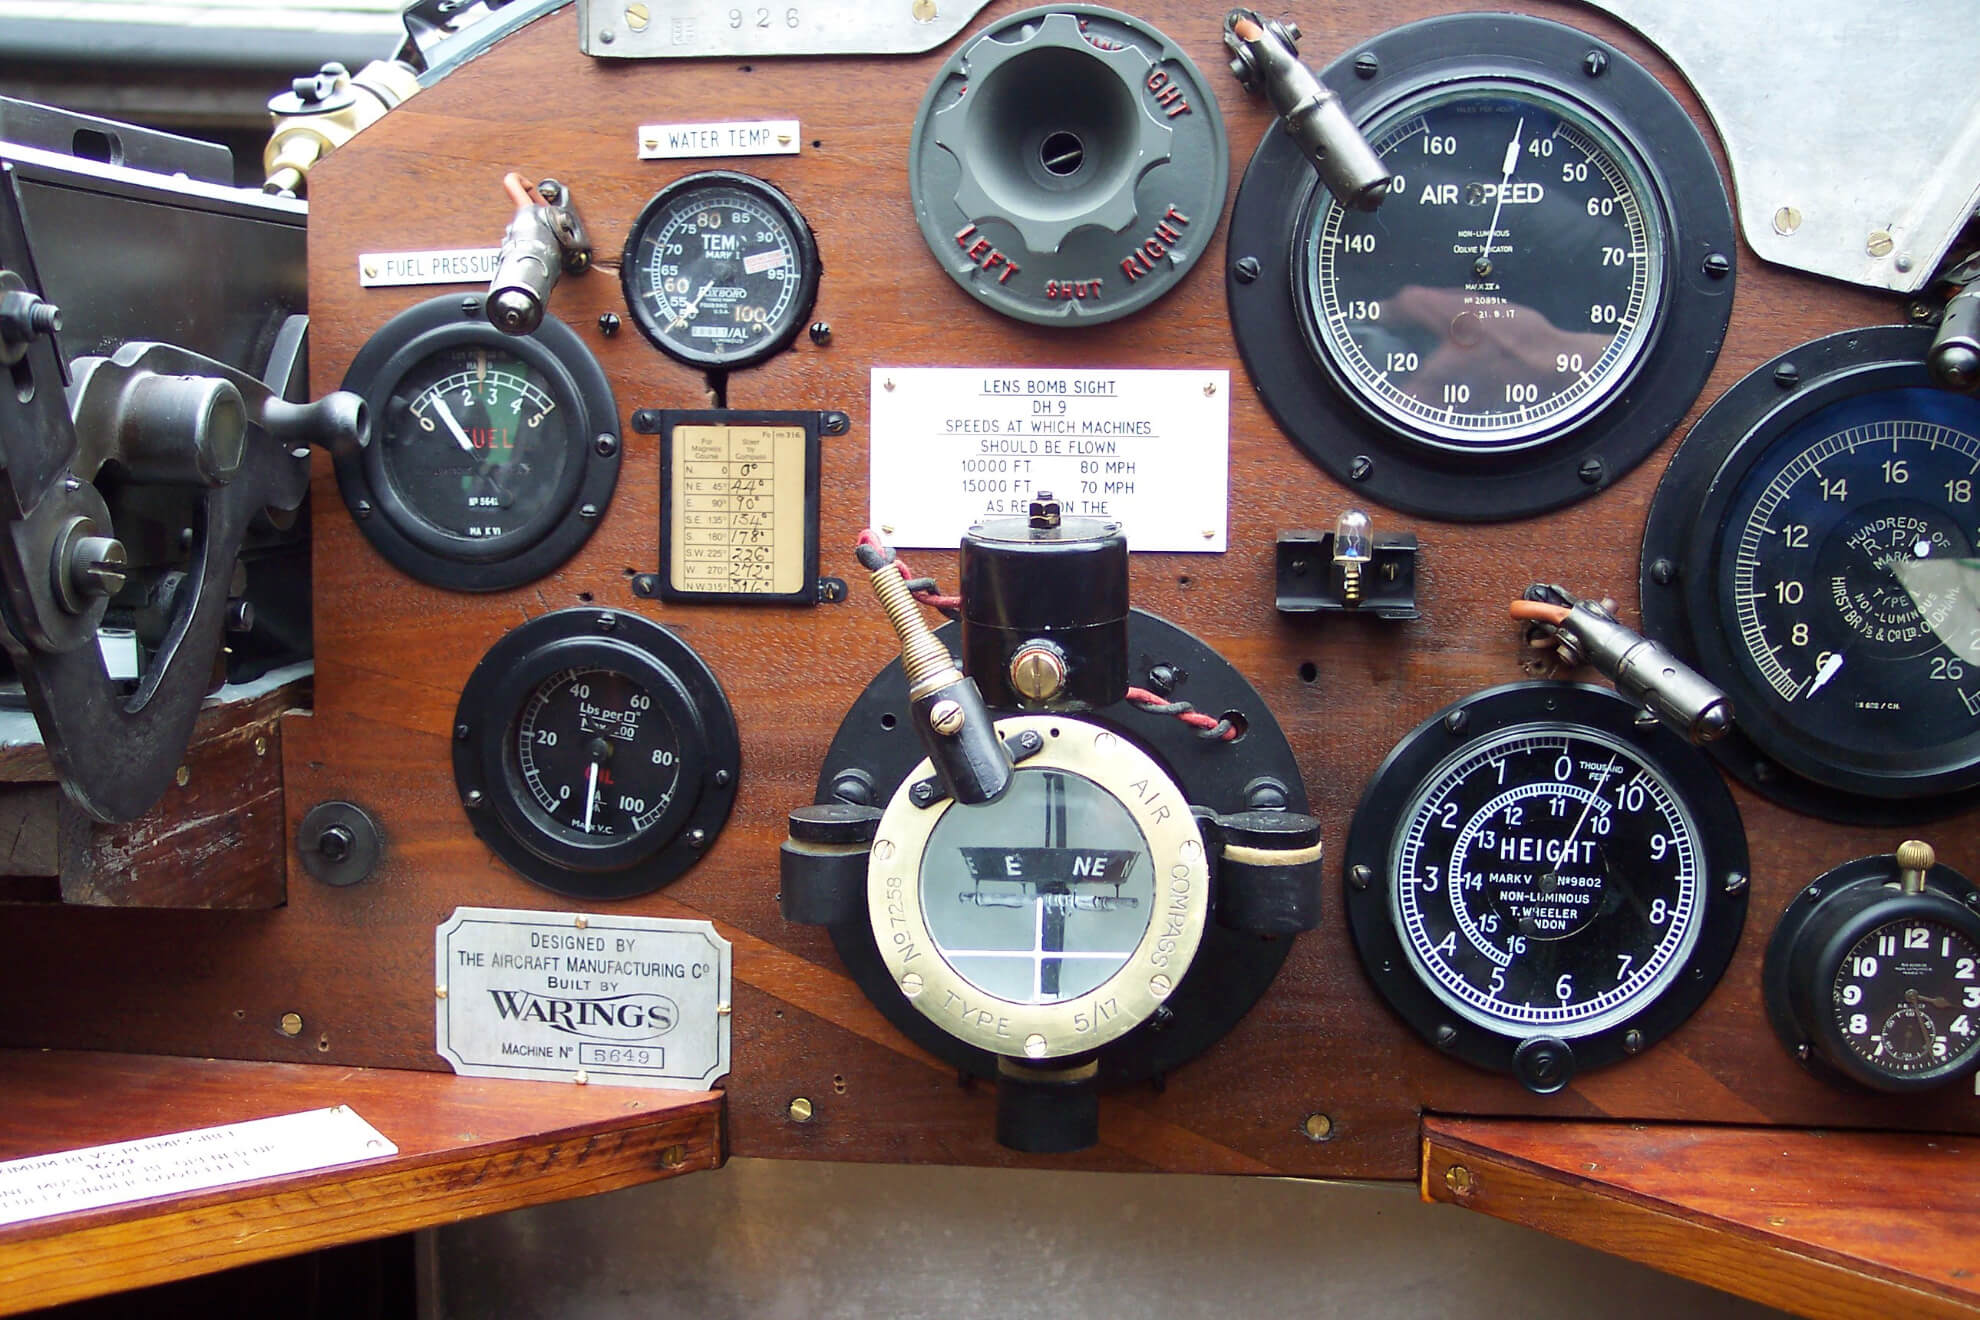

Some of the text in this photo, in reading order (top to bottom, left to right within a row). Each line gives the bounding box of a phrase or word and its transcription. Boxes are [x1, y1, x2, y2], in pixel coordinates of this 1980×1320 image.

[728, 8, 800, 28] 926
[1146, 71, 1193, 120] GHT
[668, 129, 771, 150] WATER TEMP
[1423, 136, 1457, 155] 160
[1528, 138, 1553, 158] 40
[1562, 162, 1588, 182] 50
[1419, 184, 1459, 205] AIR
[1466, 183, 1544, 205] PEED
[1586, 197, 1613, 217] 60
[697, 212, 721, 229] 80
[731, 212, 751, 223] 85
[680, 223, 697, 235] 75
[665, 244, 683, 255] 70
[1120, 204, 1190, 282] RIGHT
[1344, 233, 1376, 253] 140
[955, 223, 1021, 285] LEFT
[1601, 246, 1625, 267] 70
[387, 256, 500, 277] FUEL PRESSUR
[661, 265, 679, 276] 65
[767, 269, 785, 280] 95
[664, 277, 689, 294] 60
[1046, 279, 1103, 300] SHUT
[669, 296, 688, 307] 55
[1348, 301, 1380, 321] 130
[735, 306, 766, 323] 100
[1590, 304, 1617, 324] 80
[1386, 353, 1418, 373] 120
[1556, 354, 1582, 373] 90
[487, 388, 498, 405] 3
[983, 380, 1116, 394] LENS BOMB SIGHT
[1443, 383, 1470, 404] 110
[1504, 383, 1538, 403] 100
[462, 389, 475, 406] 2
[510, 398, 524, 415] 4
[1032, 400, 1067, 414] DH 9
[419, 416, 435, 432] 0
[527, 413, 545, 428] 5
[945, 419, 1152, 435] SPEEDS AT WHICH MACHINES
[980, 440, 1116, 455] SHOULD BE FLOWN
[961, 459, 1137, 475] 10000 FT 80 MPH
[1881, 459, 1910, 484] 16
[961, 479, 1136, 495] 15000 FT 70 MPH
[1819, 477, 1848, 502] 14
[1944, 478, 1972, 503] 18
[986, 500, 1109, 514] AS THE
[1782, 524, 1809, 548] 12
[1846, 516, 1951, 550] HUNDREDS OF
[1873, 551, 1912, 570] MARK
[1774, 581, 1804, 605] 10
[1831, 576, 1853, 612] HIRST
[1875, 627, 1884, 642] &
[1791, 622, 1809, 646] 8
[1929, 656, 1964, 681] 26
[570, 683, 590, 699] 40
[580, 702, 623, 722] Lbs per
[630, 694, 651, 710] 60
[537, 730, 557, 746] 20
[614, 726, 635, 738] 00
[652, 750, 673, 766] 80
[1496, 759, 1506, 785] 1
[1554, 756, 1572, 781] 0
[560, 785, 571, 800] 0
[1129, 778, 1171, 825] AIR
[1615, 784, 1644, 812] 10
[619, 795, 645, 814] 100
[1549, 799, 1566, 816] 11
[1441, 803, 1458, 829] 2
[1503, 807, 1523, 825] 12
[1590, 815, 1611, 835] 10
[1477, 830, 1496, 850] 13
[1650, 833, 1667, 860] 9
[1500, 837, 1596, 864] HEIGHT
[1005, 854, 1023, 876] E
[1072, 856, 1108, 877] NE
[1422, 866, 1439, 892] 3
[1463, 872, 1483, 890] 14
[1489, 873, 1532, 884] MARK V
[1150, 863, 1190, 969] COMPASS
[1649, 900, 1666, 923] 8
[1479, 914, 1498, 933] 15
[1534, 919, 1566, 930] NDON
[531, 932, 635, 952] DESIGNED BY
[1439, 931, 1456, 957] 4
[1506, 935, 1526, 954] 16
[1878, 935, 1895, 956] 11
[1904, 927, 1930, 949] 12
[1941, 936, 1950, 957] 1
[458, 950, 685, 978] THE AIRCRAFT MANUFACTURING
[1617, 954, 1633, 980] 7
[1853, 956, 1878, 977] 10
[1955, 957, 1976, 979] 2
[548, 976, 619, 992] BUILT BY
[1488, 967, 1506, 992] 5
[1555, 973, 1572, 999] 6
[1842, 985, 1862, 1006] 9
[1962, 986, 1980, 1008] 3
[486, 989, 671, 1030] WARINGS
[944, 989, 1118, 1038] TYPE 5/17
[1849, 1014, 1868, 1034] 8
[1950, 1014, 1970, 1036] 4
[502, 1043, 650, 1063] MACHINE 5649
[1870, 1035, 1884, 1056] 7
[1932, 1036, 1948, 1056] 5
